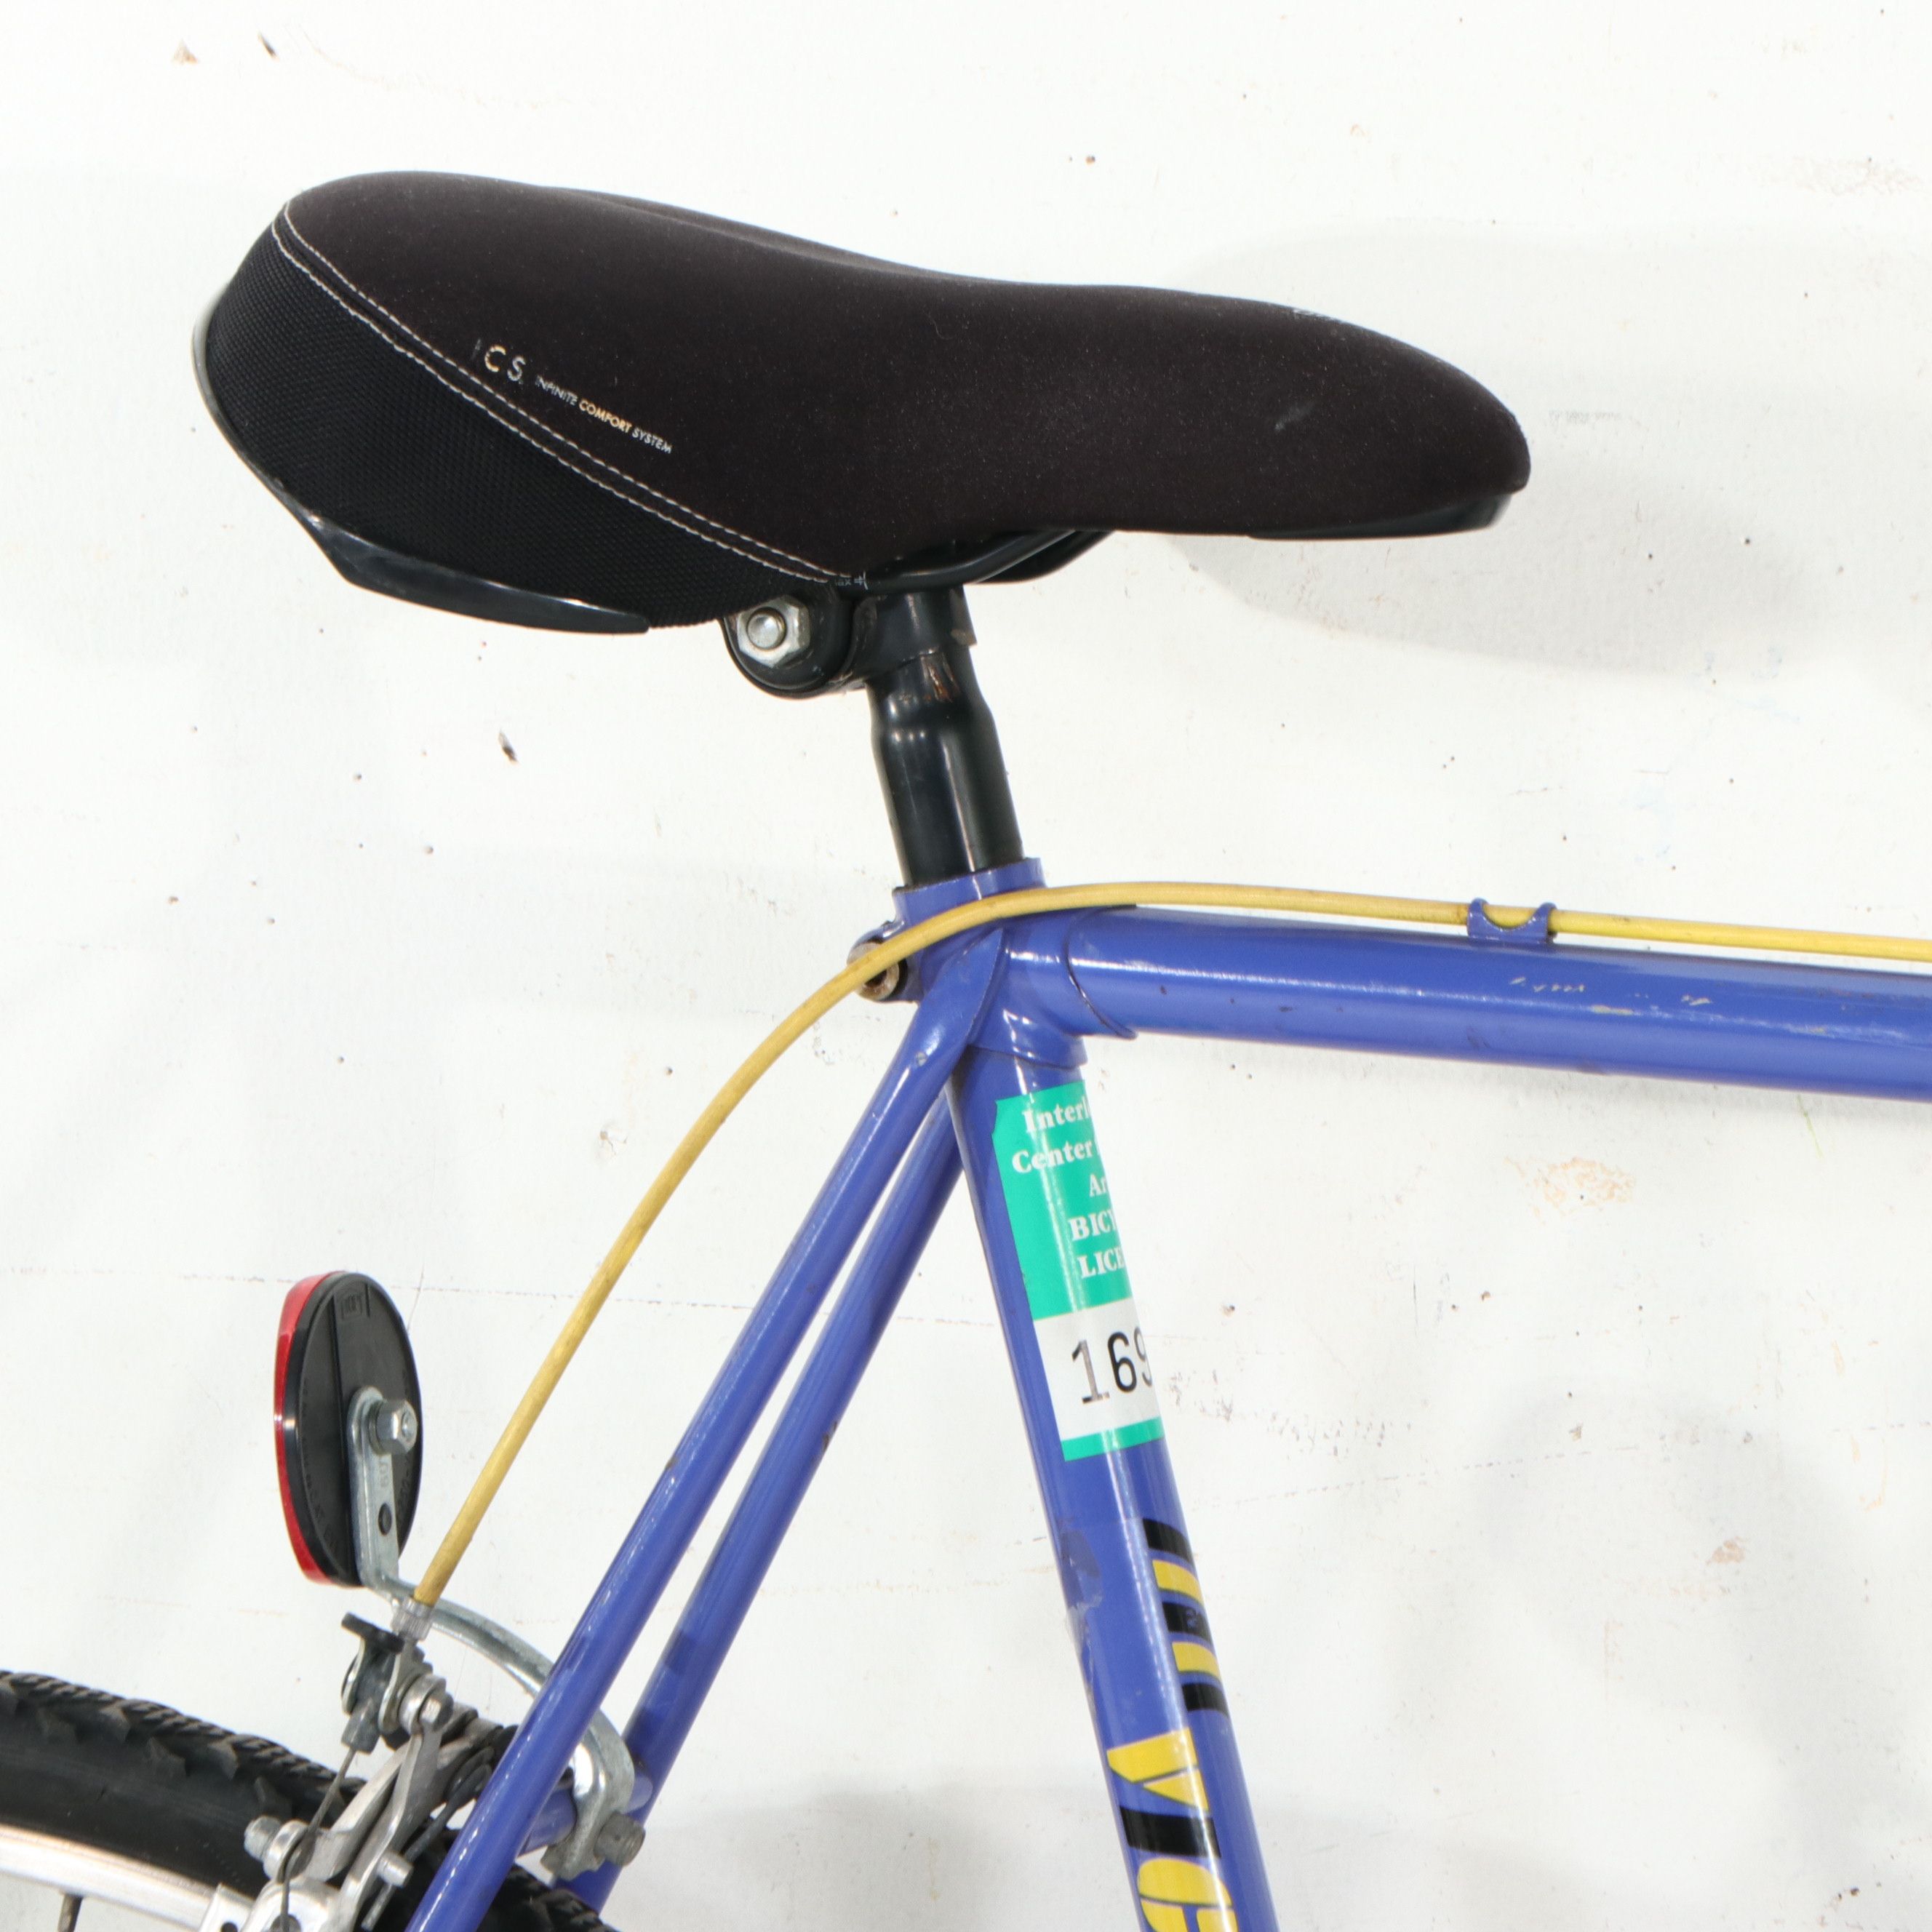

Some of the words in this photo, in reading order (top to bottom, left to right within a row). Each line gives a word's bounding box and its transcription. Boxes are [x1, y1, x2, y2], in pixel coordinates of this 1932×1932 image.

[579, 398, 633, 434] COMFORT
[631, 427, 673, 454] SYSTEM
[1011, 1140, 1093, 1173] Center
